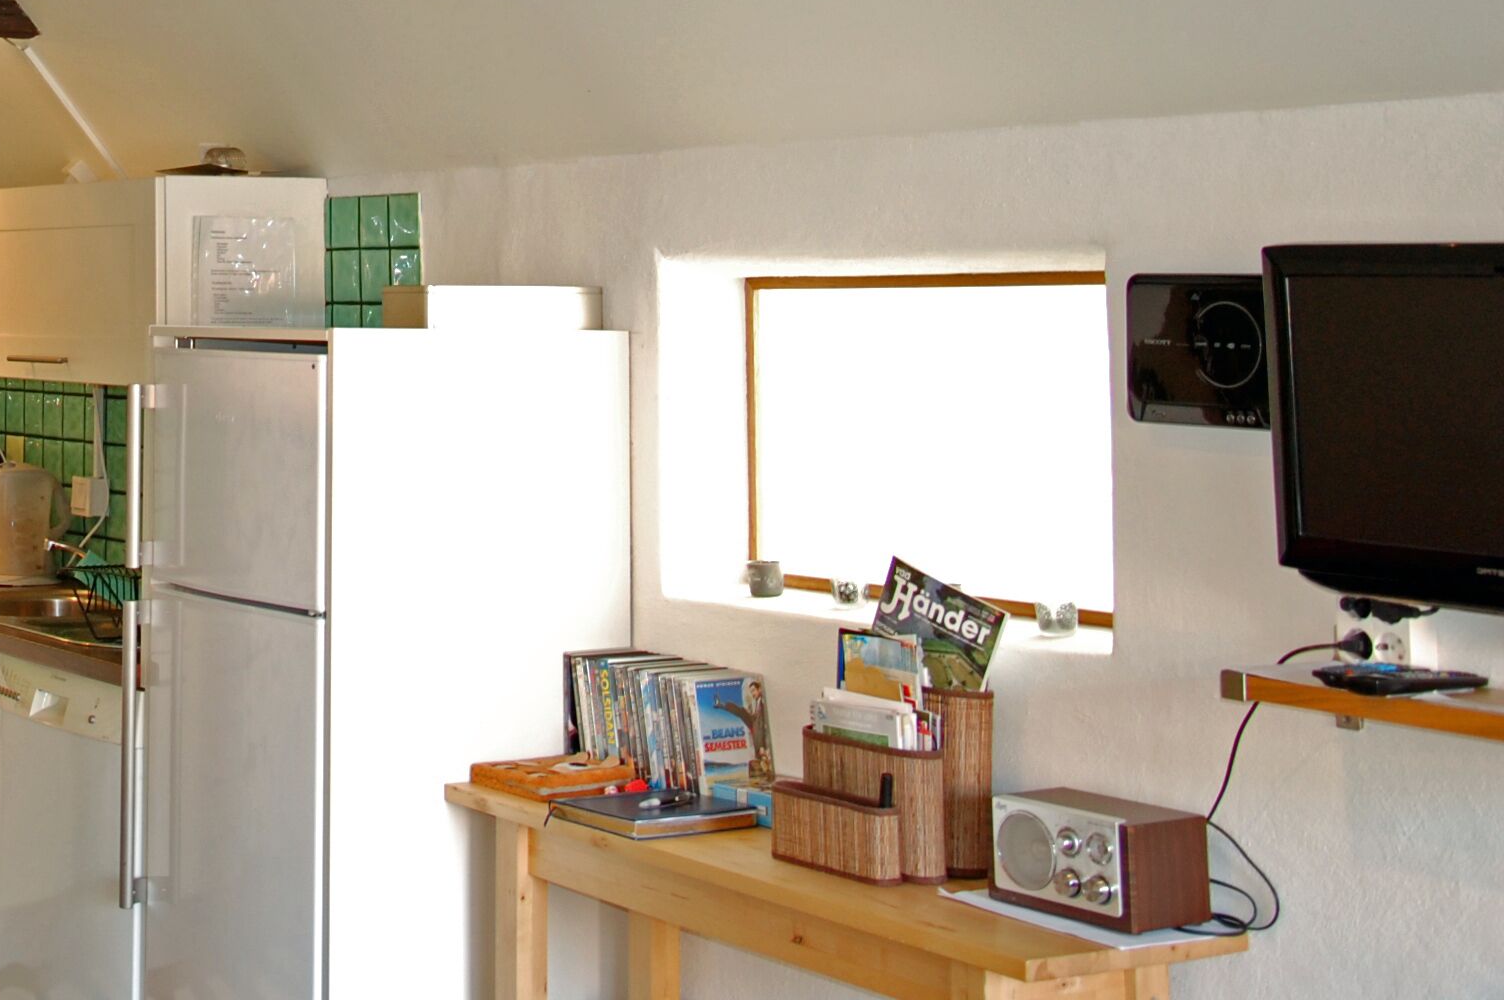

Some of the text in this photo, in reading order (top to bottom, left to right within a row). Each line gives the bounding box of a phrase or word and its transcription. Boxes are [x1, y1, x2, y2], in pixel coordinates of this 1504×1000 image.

[880, 575, 992, 645] Händer
[600, 669, 615, 744] SOLSIDAN
[704, 739, 747, 752] SEMESTER
[711, 727, 746, 739] BEANS
